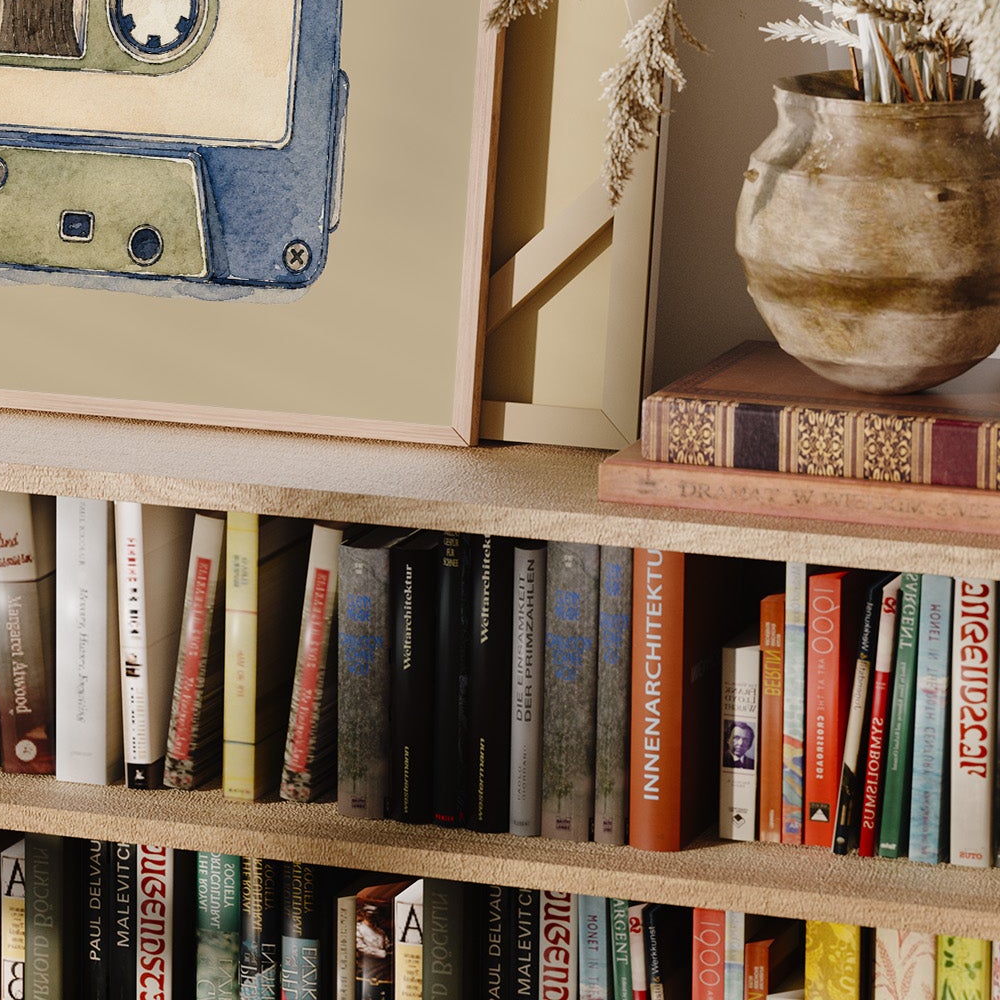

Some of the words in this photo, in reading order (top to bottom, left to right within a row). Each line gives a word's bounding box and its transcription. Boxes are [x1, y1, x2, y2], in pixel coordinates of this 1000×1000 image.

[6, 595, 23, 656] Margaret
[403, 563, 413, 671] Weltarchitektur
[516, 575, 526, 686] EINSAMKEIT
[524, 558, 536, 679] PRIMZAHLEN
[12, 660, 32, 715] Atwood
[516, 692, 524, 722] DIE
[524, 685, 534, 722] DER
[643, 549, 664, 801] INNENARCHITEKTU
[478, 737, 486, 821] westermann
[89, 916, 101, 961] PAUL
[587, 914, 598, 953] MONET
[693, 920, 721, 988] 1900
